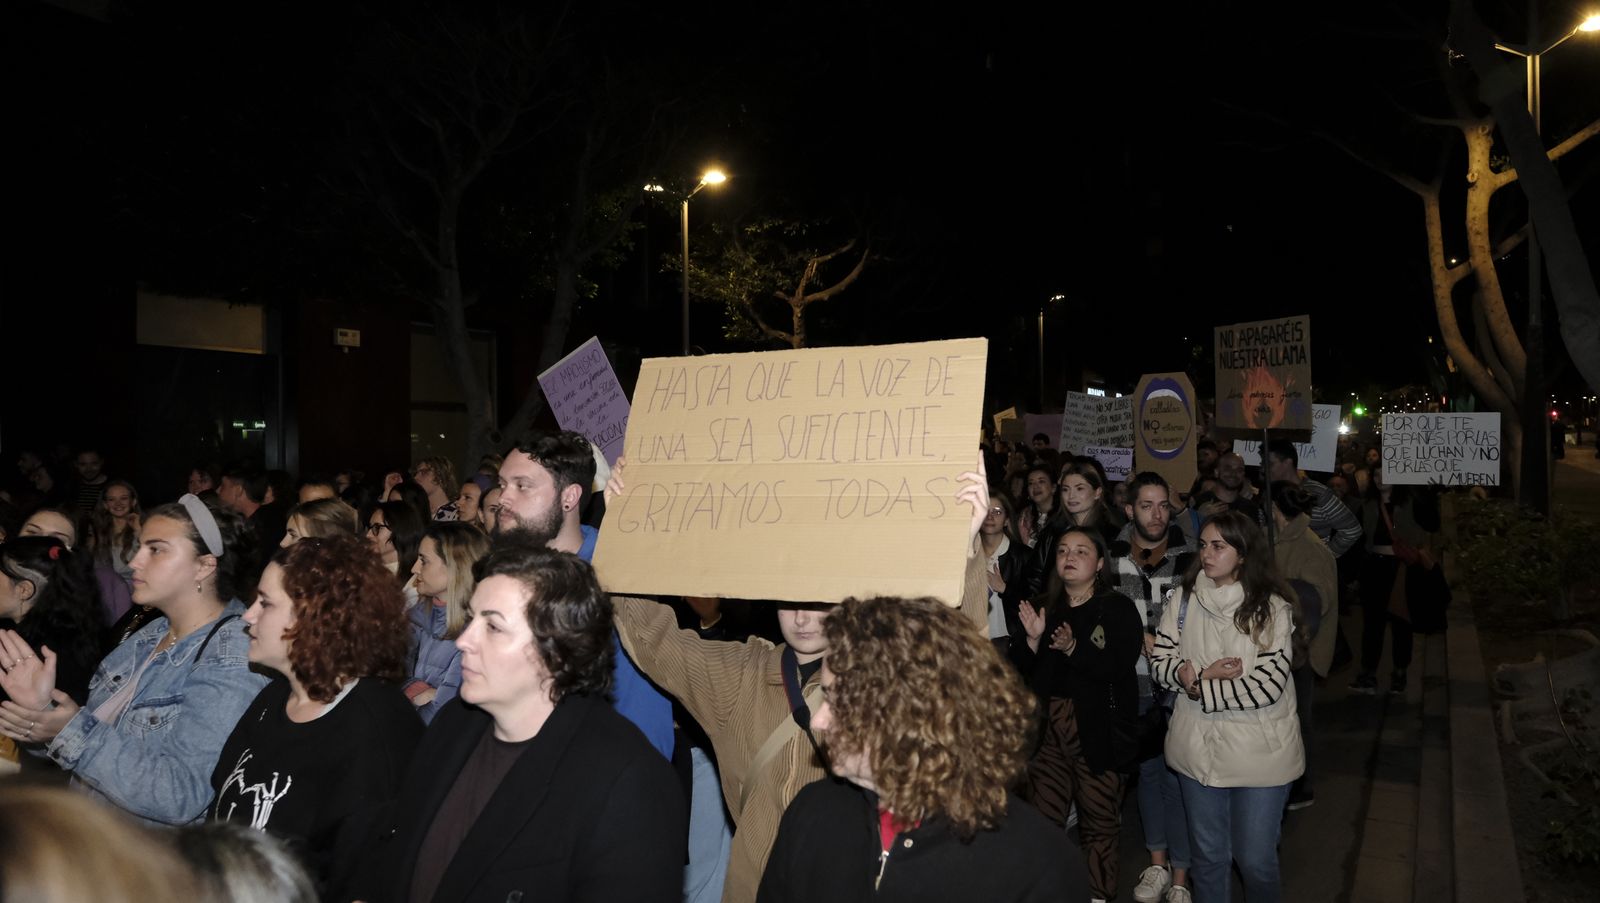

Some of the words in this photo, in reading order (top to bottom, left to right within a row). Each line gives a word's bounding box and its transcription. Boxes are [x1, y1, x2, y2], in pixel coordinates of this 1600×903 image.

[1220, 329, 1234, 349] NO
[559, 349, 601, 384] MACHISMO
[1219, 348, 1268, 370] NUESTRA
[1269, 344, 1307, 367] LLAMA
[647, 363, 731, 414] HASTA
[745, 360, 800, 402] QUE
[815, 357, 845, 399] LA
[858, 357, 912, 398] VOZ
[924, 355, 962, 397] DE
[1385, 415, 1413, 431] POR
[1417, 415, 1445, 431] QUE
[1451, 415, 1475, 430] TE
[638, 432, 688, 464] UNA
[706, 417, 755, 465] SEA
[772, 405, 948, 464] SUFICIENTE,
[1383, 446, 1412, 460] QUE
[1416, 445, 1465, 460] LUCHAN
[1469, 447, 1478, 460] Y
[1479, 446, 1500, 461] NO
[1434, 459, 1463, 473] QUE
[1447, 472, 1497, 485] MUEREN
[617, 479, 786, 534] GRITAMOS
[815, 475, 950, 521] TODAS
